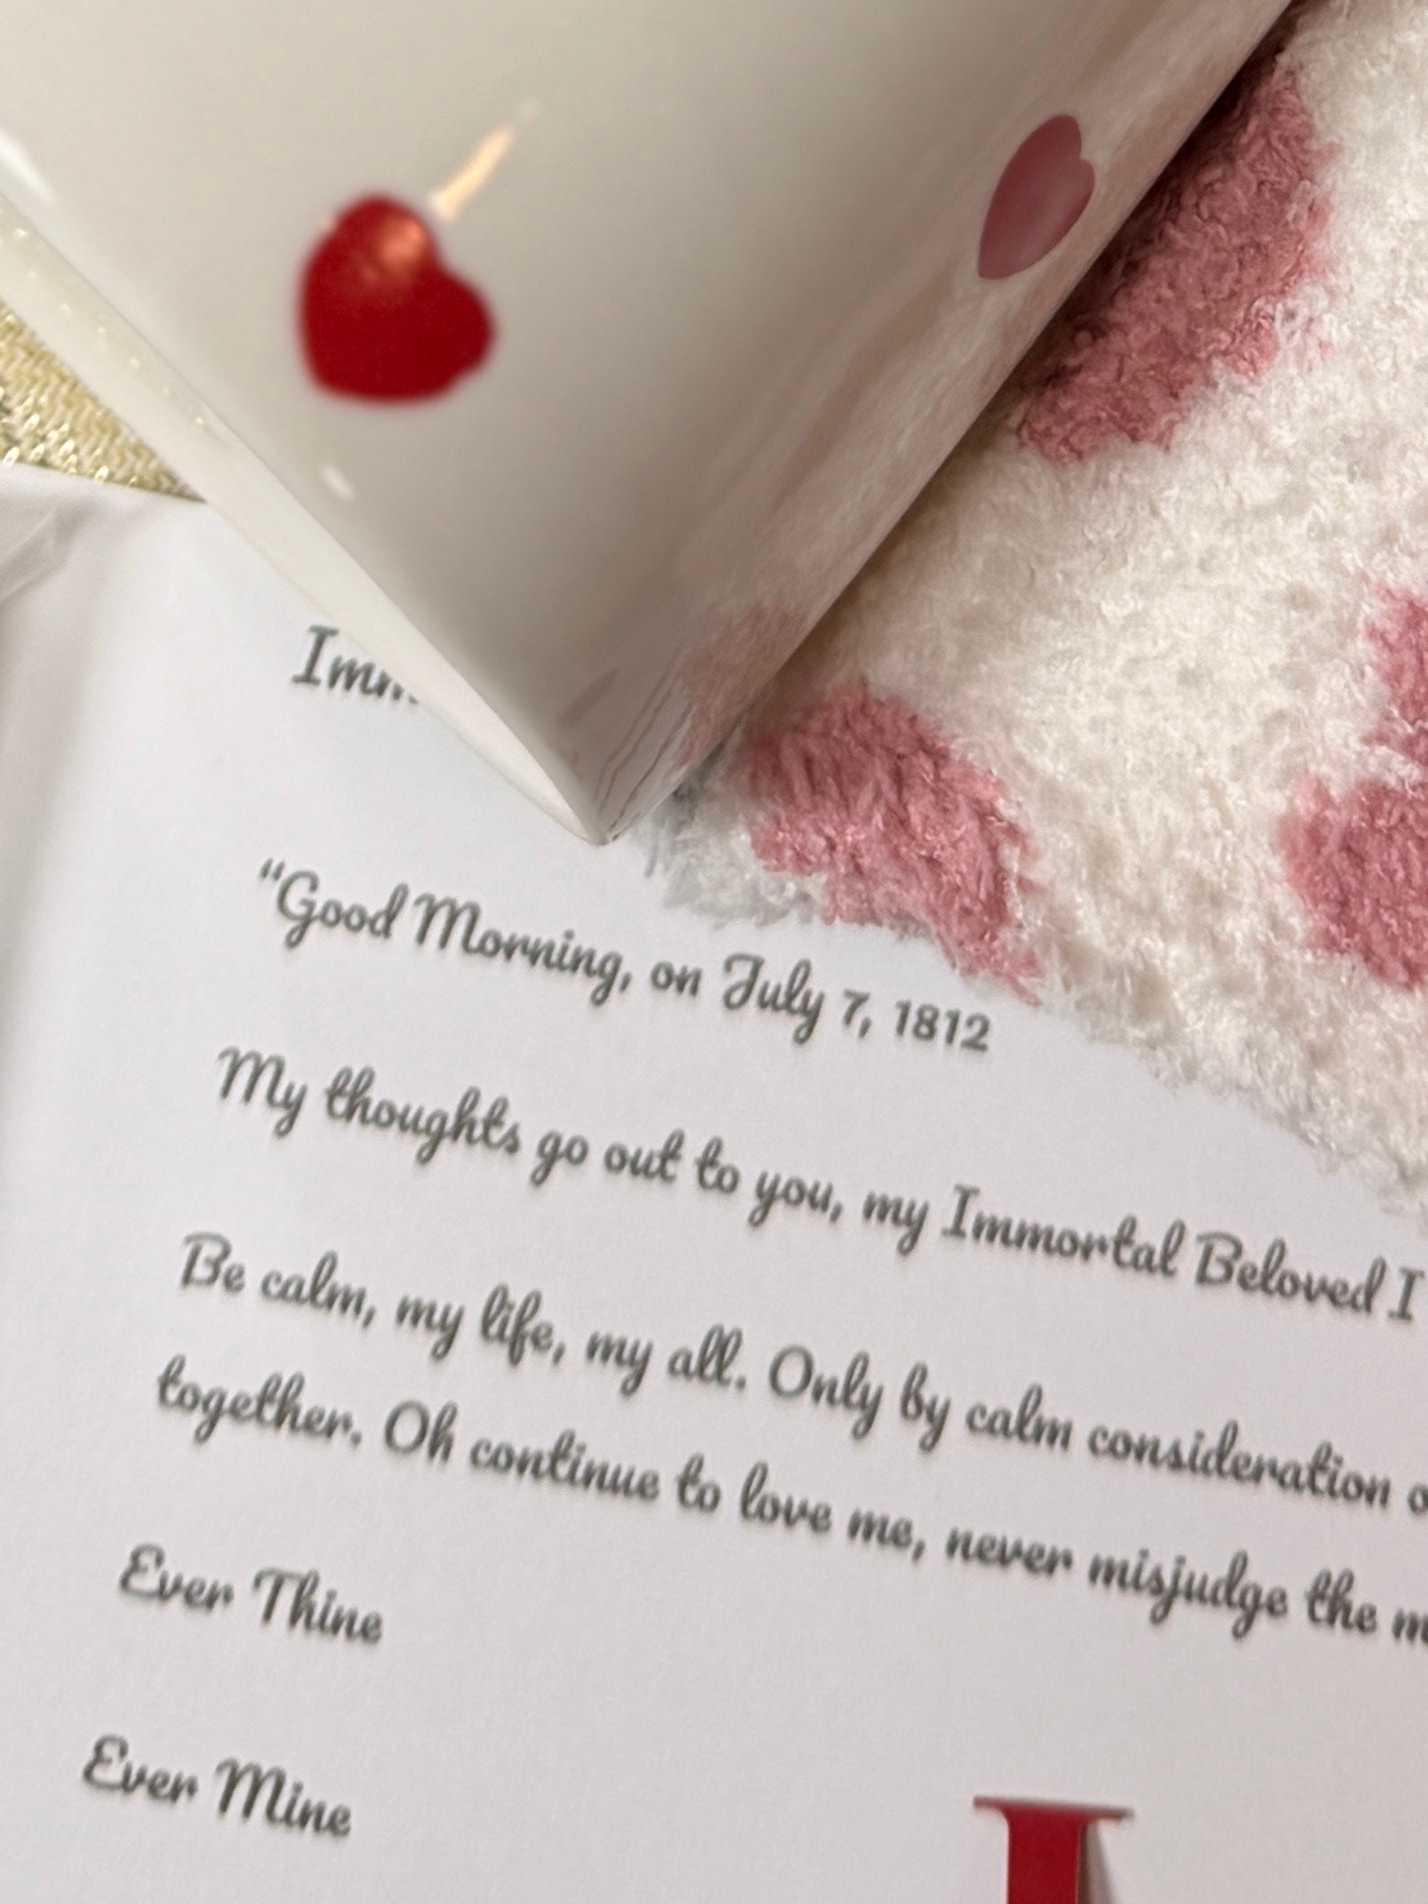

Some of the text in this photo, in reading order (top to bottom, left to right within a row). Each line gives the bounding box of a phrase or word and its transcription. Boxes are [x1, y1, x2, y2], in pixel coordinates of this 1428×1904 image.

[413, 892, 633, 1007] Morning,
[649, 961, 702, 998] on
[722, 952, 825, 1046] July
[841, 990, 872, 1039] 7,
[894, 1000, 991, 1055] 1812
[217, 1047, 307, 1139] My
[323, 1066, 521, 1166] thoughts
[530, 1129, 588, 1189] go
[603, 1128, 684, 1187] out
[695, 1137, 740, 1197] to
[747, 1171, 844, 1230] you,
[862, 1192, 929, 1258] my
[941, 1183, 1187, 1284] Immortal
[1194, 1230, 1388, 1318] Beloved
[1387, 1267, 1425, 1324] I
[178, 1232, 246, 1296] Be
[258, 1250, 376, 1329] calm,
[395, 1295, 465, 1363] my
[478, 1284, 566, 1370] life,
[585, 1330, 653, 1398] my
[667, 1325, 747, 1393] all.
[768, 1344, 884, 1443] Only
[899, 1362, 951, 1456] by
[965, 1383, 1073, 1455] calm
[1087, 1419, 1392, 1512] consideration
[117, 1543, 383, 1648] Ever Thine
[156, 1354, 362, 1448] together.
[383, 1400, 456, 1464] Oh
[468, 1429, 660, 1507] continue
[674, 1453, 722, 1517] to
[739, 1461, 833, 1537] love
[847, 1506, 926, 1565] me,
[944, 1525, 1074, 1582] never
[1087, 1548, 1289, 1646] misjudge
[1304, 1567, 1378, 1637] the
[82, 1734, 352, 1842] Ever Mine
